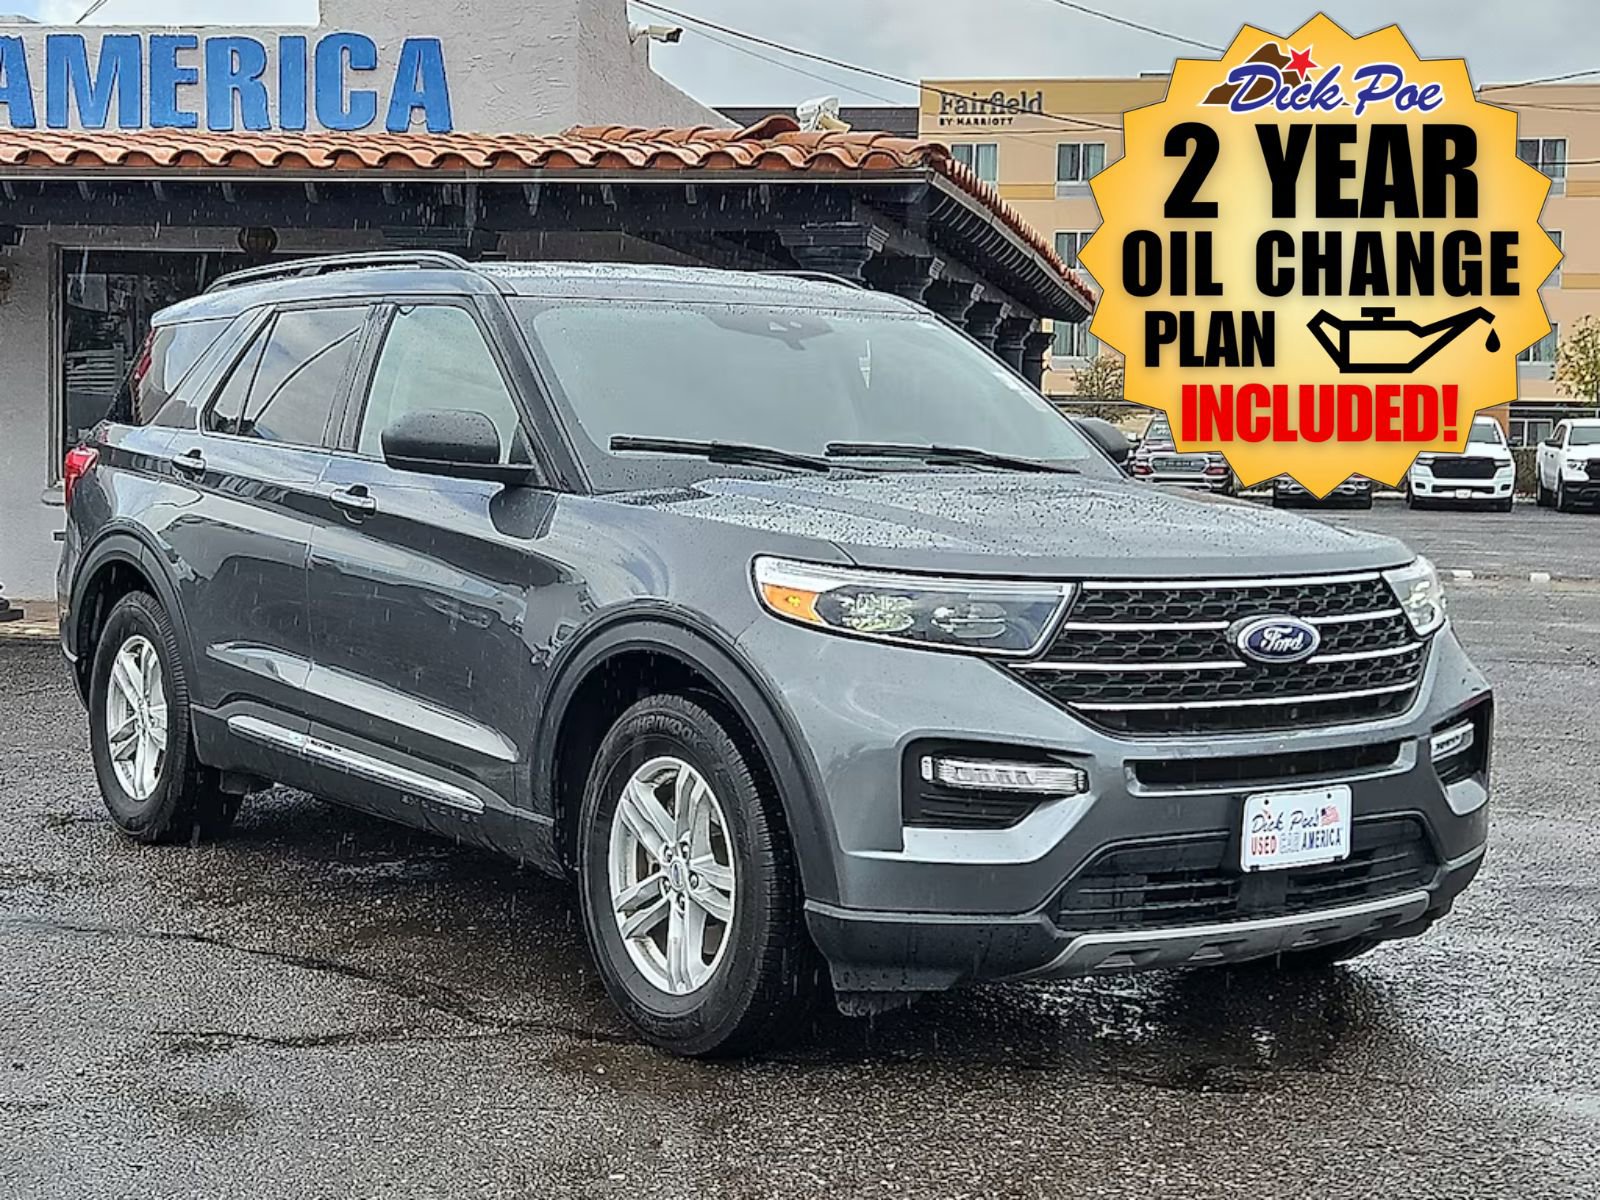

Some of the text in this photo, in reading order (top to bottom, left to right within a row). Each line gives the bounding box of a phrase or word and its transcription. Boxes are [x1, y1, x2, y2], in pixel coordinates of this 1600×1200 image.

[939, 91, 1043, 115] Fairfield
[940, 116, 1013, 126] BY MARRIOTT
[1260, 627, 1304, 652] Ford
[1251, 811, 1284, 833] Dick
[1251, 835, 1277, 855] USED
[1301, 827, 1343, 850] AMERICA
